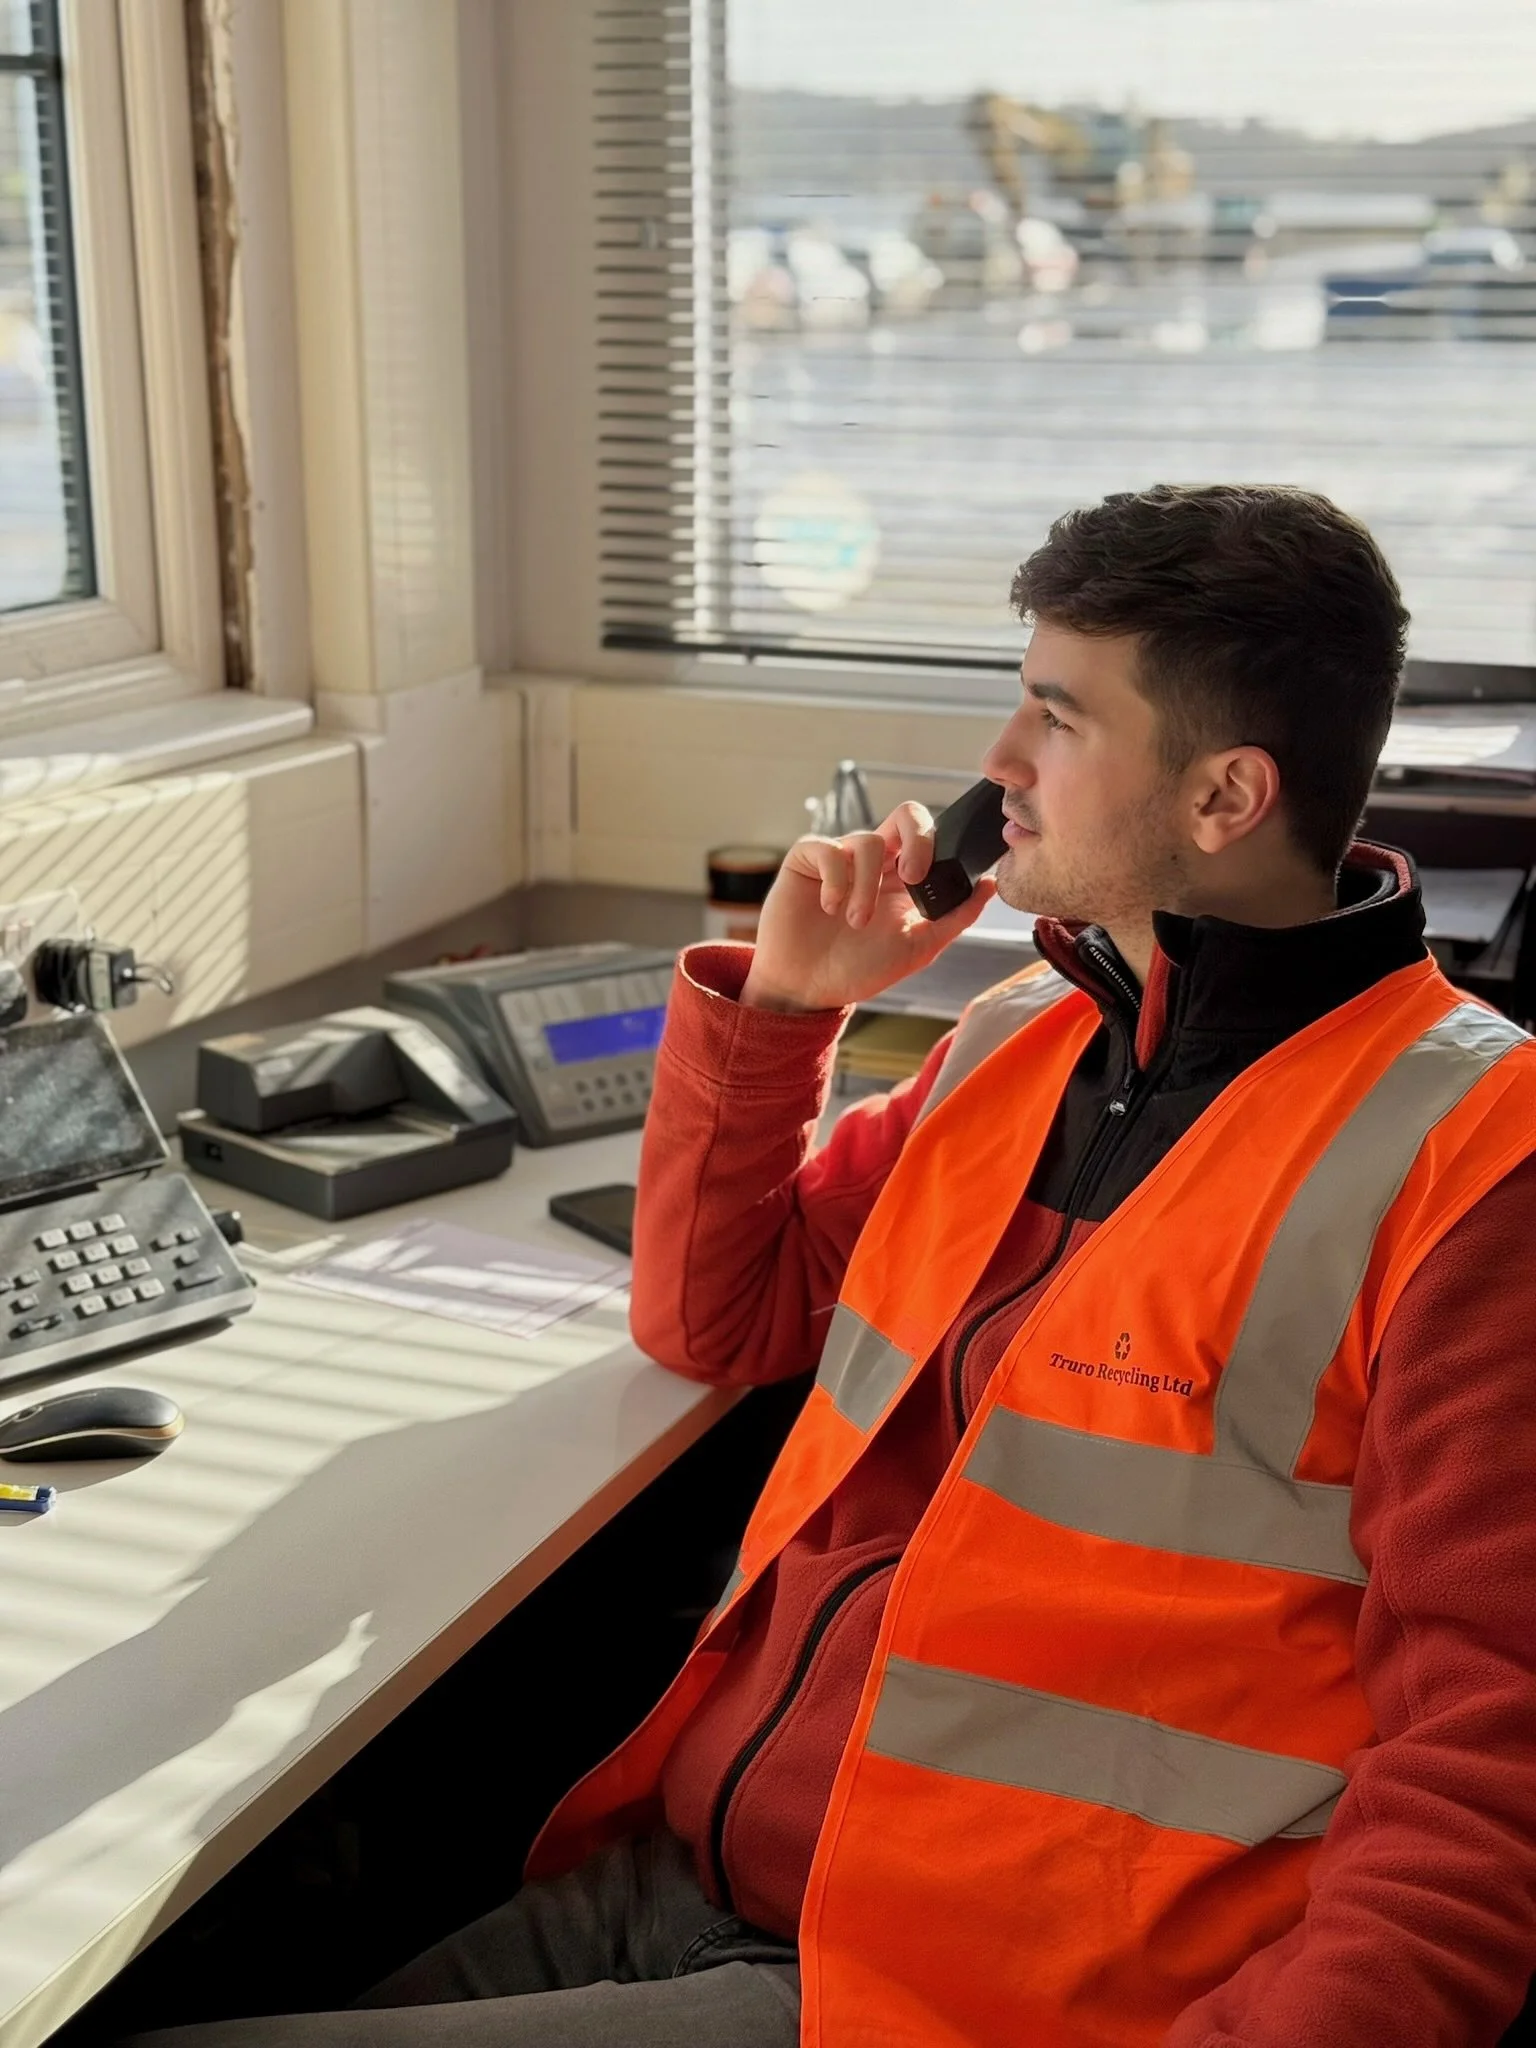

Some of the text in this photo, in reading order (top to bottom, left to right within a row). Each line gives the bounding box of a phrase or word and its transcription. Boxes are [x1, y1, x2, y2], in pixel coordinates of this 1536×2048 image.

[1049, 1353, 1194, 1397] Truro Recycling Ltd
